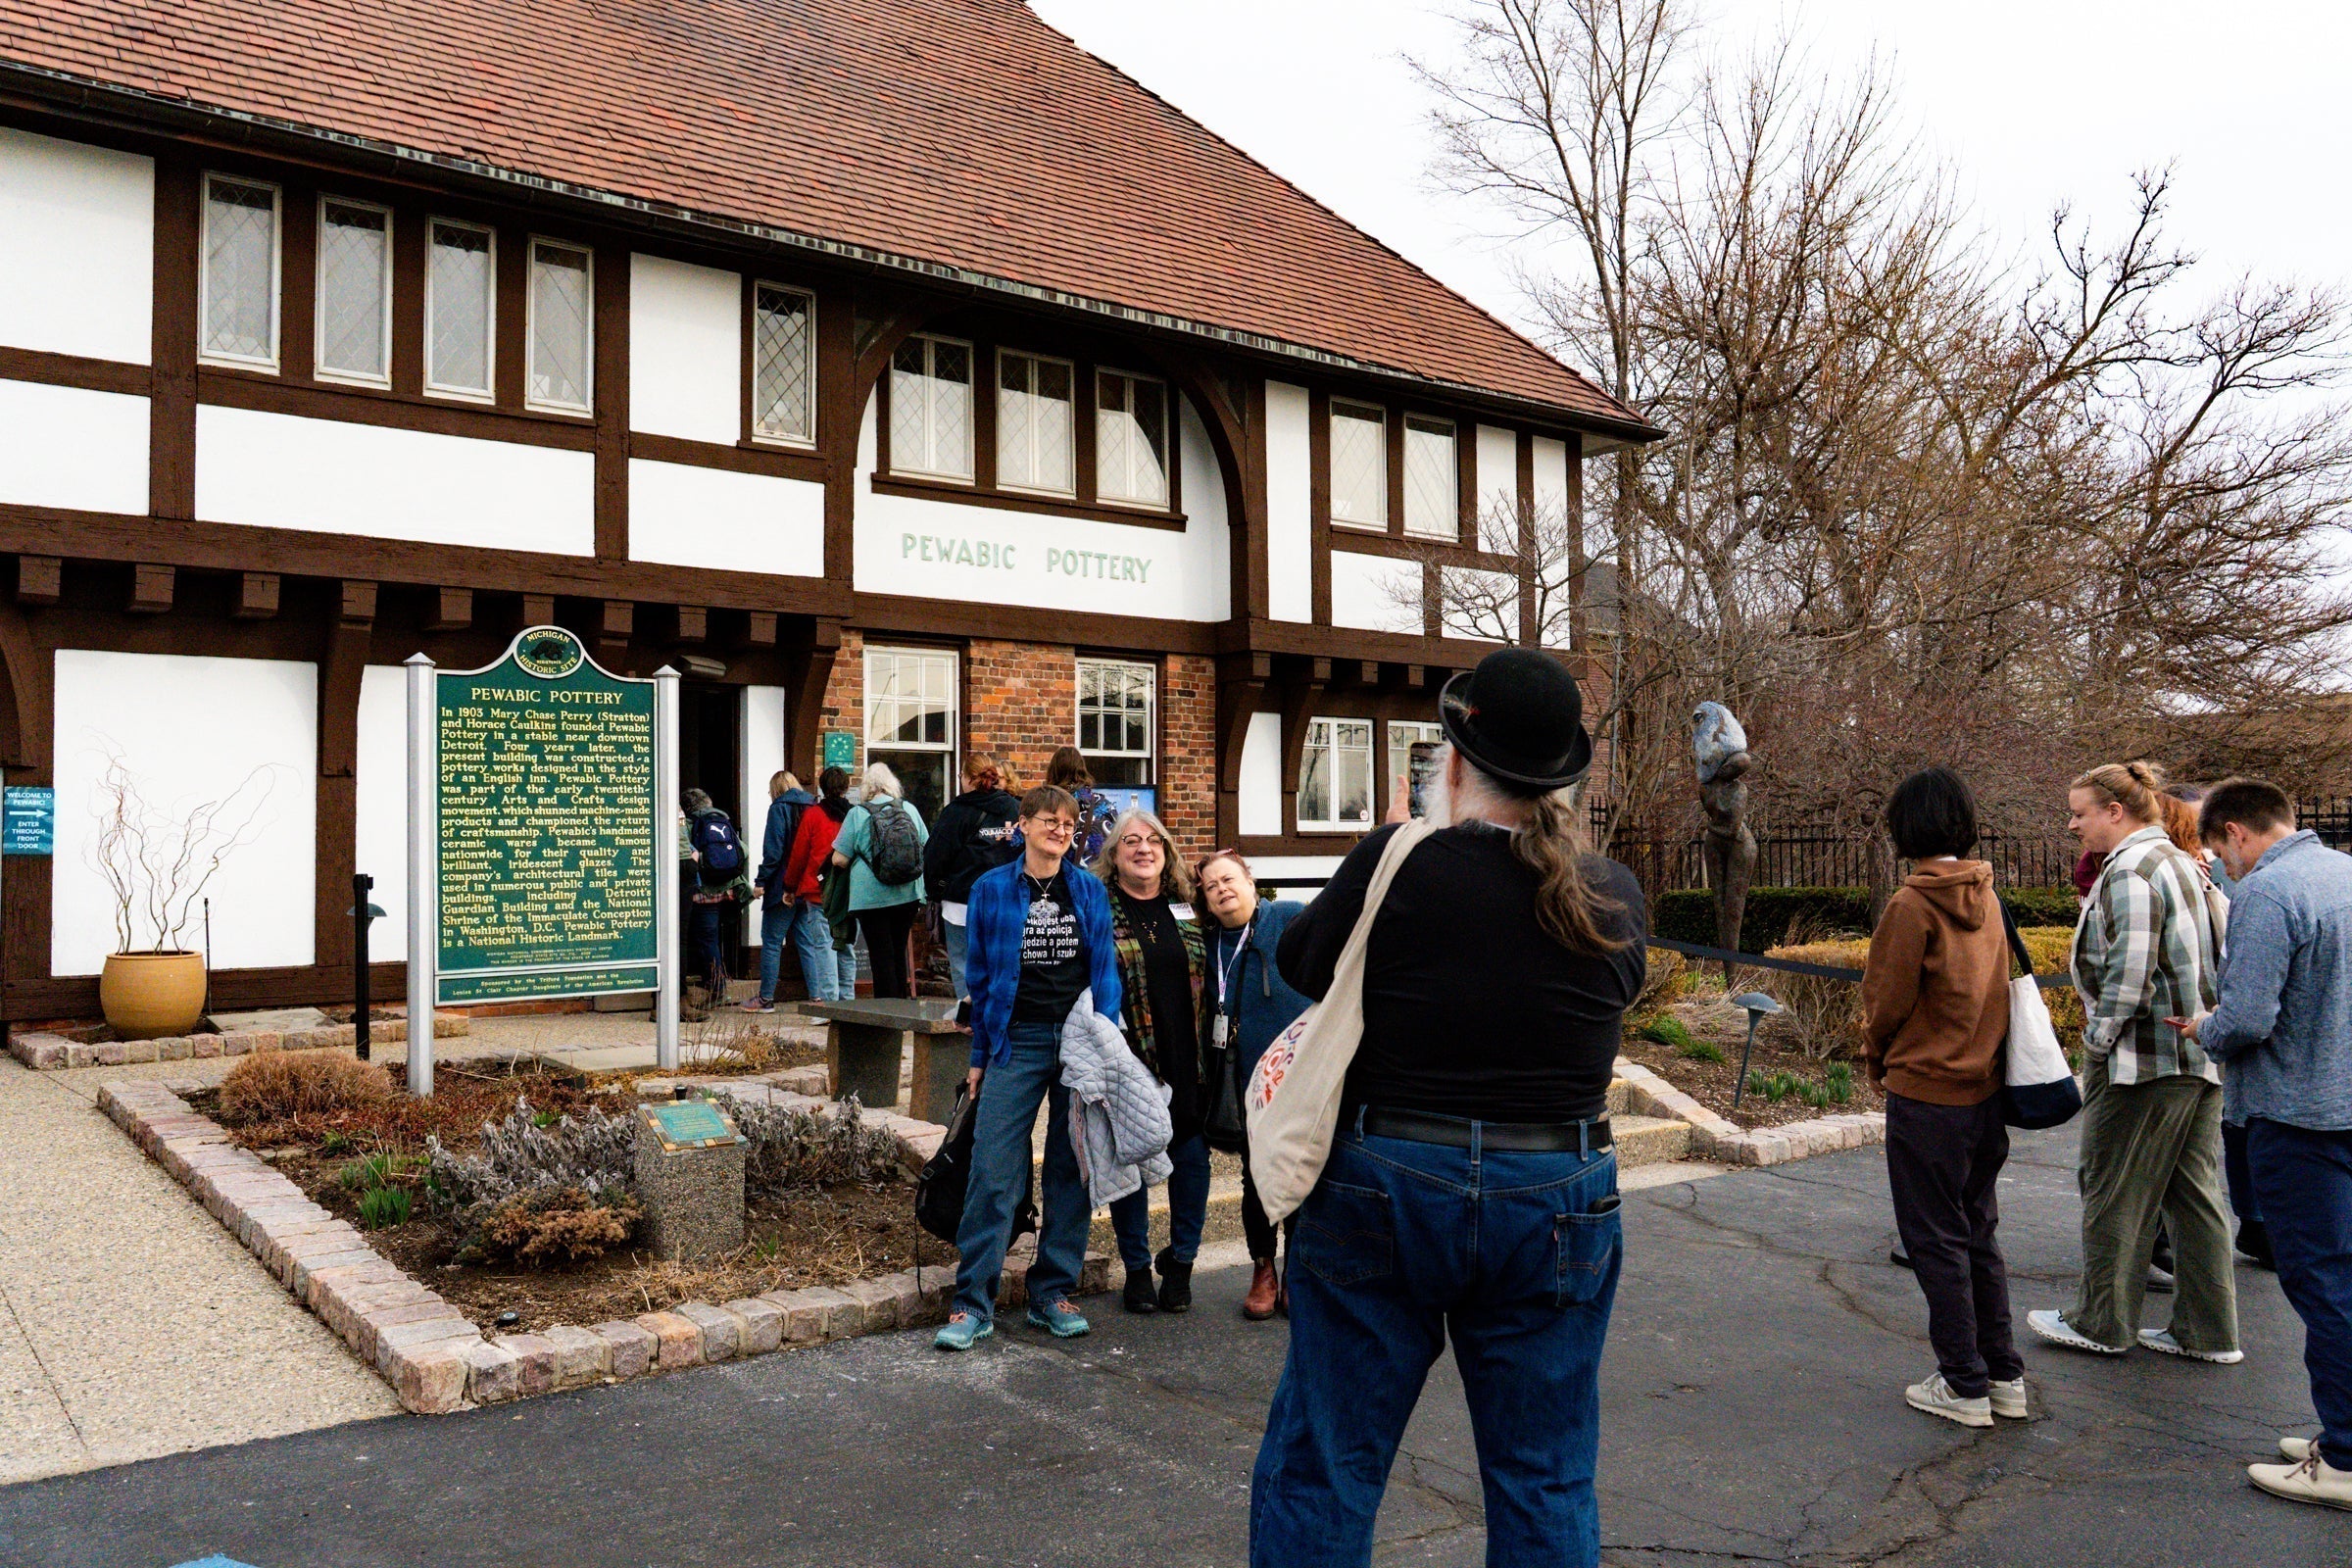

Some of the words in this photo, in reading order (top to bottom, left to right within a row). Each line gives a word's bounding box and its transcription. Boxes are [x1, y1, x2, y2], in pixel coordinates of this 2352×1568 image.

[902, 533, 1016, 570] PEWABIC
[1047, 547, 1152, 584] POTTERY
[527, 631, 570, 643] MICHIGAN
[519, 654, 557, 674] HISTORIC
[560, 657, 577, 672] SITE
[471, 688, 541, 702] PEWABIC
[550, 691, 623, 704] POTTERY
[441, 707, 453, 717] In
[459, 707, 483, 717] 1903
[491, 708, 520, 720] Mary
[525, 710, 556, 719] Chase
[561, 711, 593, 721] Perry
[597, 712, 649, 722] (Stratton)
[441, 718, 462, 728] and
[466, 719, 506, 729] Horace
[510, 720, 556, 730] Caulkins
[561, 721, 604, 731] founded
[609, 722, 649, 732] Pewabic
[441, 729, 487, 740] Pottery
[494, 731, 504, 739] in
[525, 731, 558, 740] stable
[597, 733, 649, 742] downtown
[441, 740, 487, 750] Detroit.
[504, 741, 529, 751] Four
[544, 744, 574, 753] years
[633, 743, 649, 753] the
[441, 752, 485, 763] present
[493, 752, 537, 763] building
[442, 763, 487, 773] pottery
[493, 763, 525, 772] works
[531, 763, 578, 774] designed
[584, 764, 594, 773] in
[599, 764, 617, 773] the
[623, 764, 650, 774] style
[441, 773, 455, 783] of
[483, 773, 523, 784] English
[530, 774, 550, 783] inn.
[559, 774, 602, 783] Pewabic
[609, 774, 650, 784] Pottery
[470, 785, 495, 795] part
[504, 785, 516, 793] of
[526, 784, 545, 793] the
[554, 784, 583, 795] early
[594, 785, 650, 793] twentieth-
[441, 795, 487, 805] century
[501, 795, 527, 804] Arts
[538, 795, 557, 804] and
[571, 795, 605, 804] Crafts
[617, 795, 650, 806] design
[502, 806, 533, 815] which
[534, 806, 577, 815] shunned
[579, 806, 650, 815] machine-made
[442, 817, 492, 828] products
[498, 817, 518, 826] and
[526, 816, 588, 828] championed
[594, 816, 611, 825] the
[616, 816, 650, 825] return
[442, 828, 455, 837] of
[460, 827, 542, 838] craftsmanship.
[548, 826, 597, 836] Pewabic's
[599, 826, 650, 835] handmade
[442, 839, 486, 848] ceramic
[557, 837, 596, 846] became
[614, 837, 651, 845] famous
[442, 849, 503, 859] nationwide
[514, 848, 531, 858] for
[542, 848, 569, 857] their
[579, 847, 619, 859] quality
[632, 847, 650, 856] and
[509, 859, 563, 869] iridescent
[579, 858, 614, 868] glazes.
[630, 857, 651, 866] The
[442, 871, 501, 883] company's
[513, 869, 585, 879] architectural
[595, 868, 618, 877] tiles
[442, 882, 468, 892] used
[474, 883, 485, 891] in
[491, 882, 544, 891] numerous
[550, 880, 583, 891] public
[589, 878, 608, 887] and
[614, 878, 651, 889] private
[527, 891, 577, 901] including
[605, 888, 651, 897] Detroit's
[442, 904, 495, 914] Guardian
[502, 902, 548, 913] Building
[554, 901, 574, 910] and
[583, 900, 600, 909] the
[608, 898, 651, 908] National
[443, 916, 480, 925] Shrine
[486, 914, 498, 923] of
[504, 914, 523, 923] the
[528, 911, 588, 921] Immaculate
[593, 909, 651, 919] Conception
[443, 928, 453, 936] in
[533, 923, 555, 932] D.C.
[564, 921, 605, 931] Pewabic
[611, 920, 651, 929] Pottery
[1047, 925, 1072, 936] policja
[443, 939, 452, 947] is
[469, 935, 515, 946] National
[520, 933, 564, 944] Historic
[568, 930, 623, 941] Landmark.
[1056, 937, 1078, 948] potem
